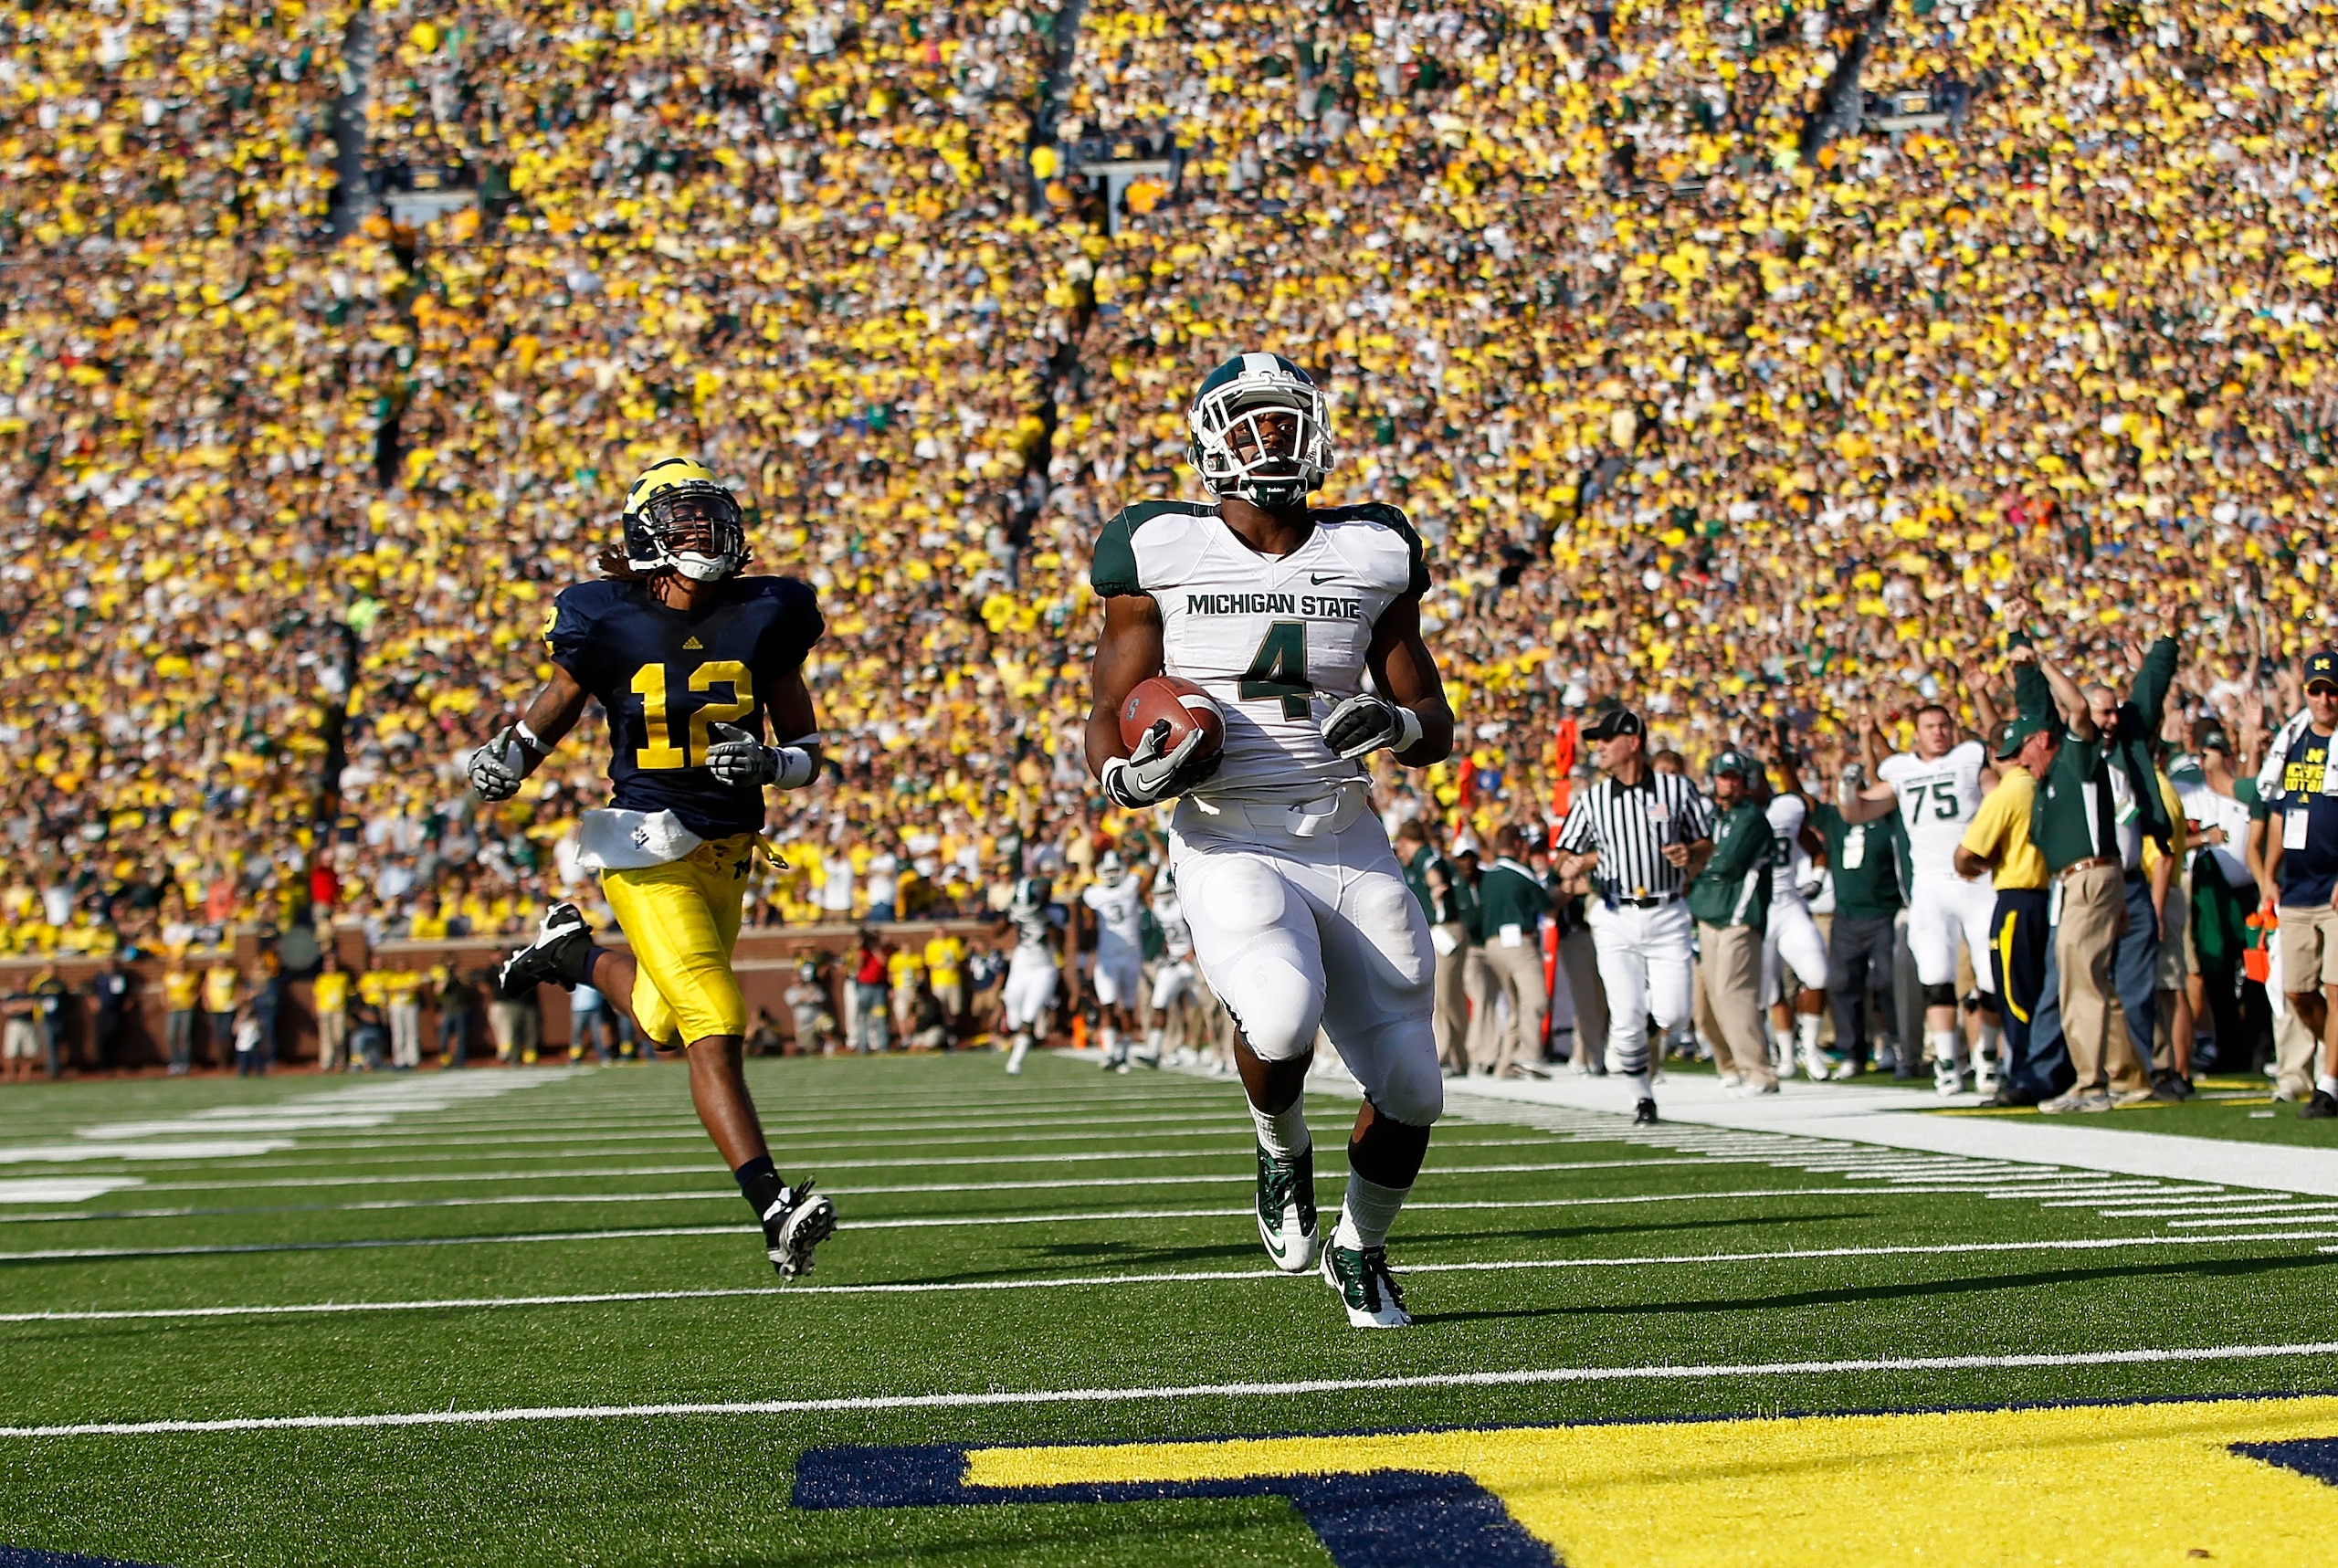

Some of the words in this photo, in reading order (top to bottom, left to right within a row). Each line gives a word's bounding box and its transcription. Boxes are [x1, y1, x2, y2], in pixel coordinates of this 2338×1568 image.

[1186, 594, 1295, 615] MICHIGAN
[1301, 595, 1362, 618] STATE
[1238, 620, 1315, 722] 4
[631, 660, 754, 770] 12
[1907, 781, 1959, 825] 75
